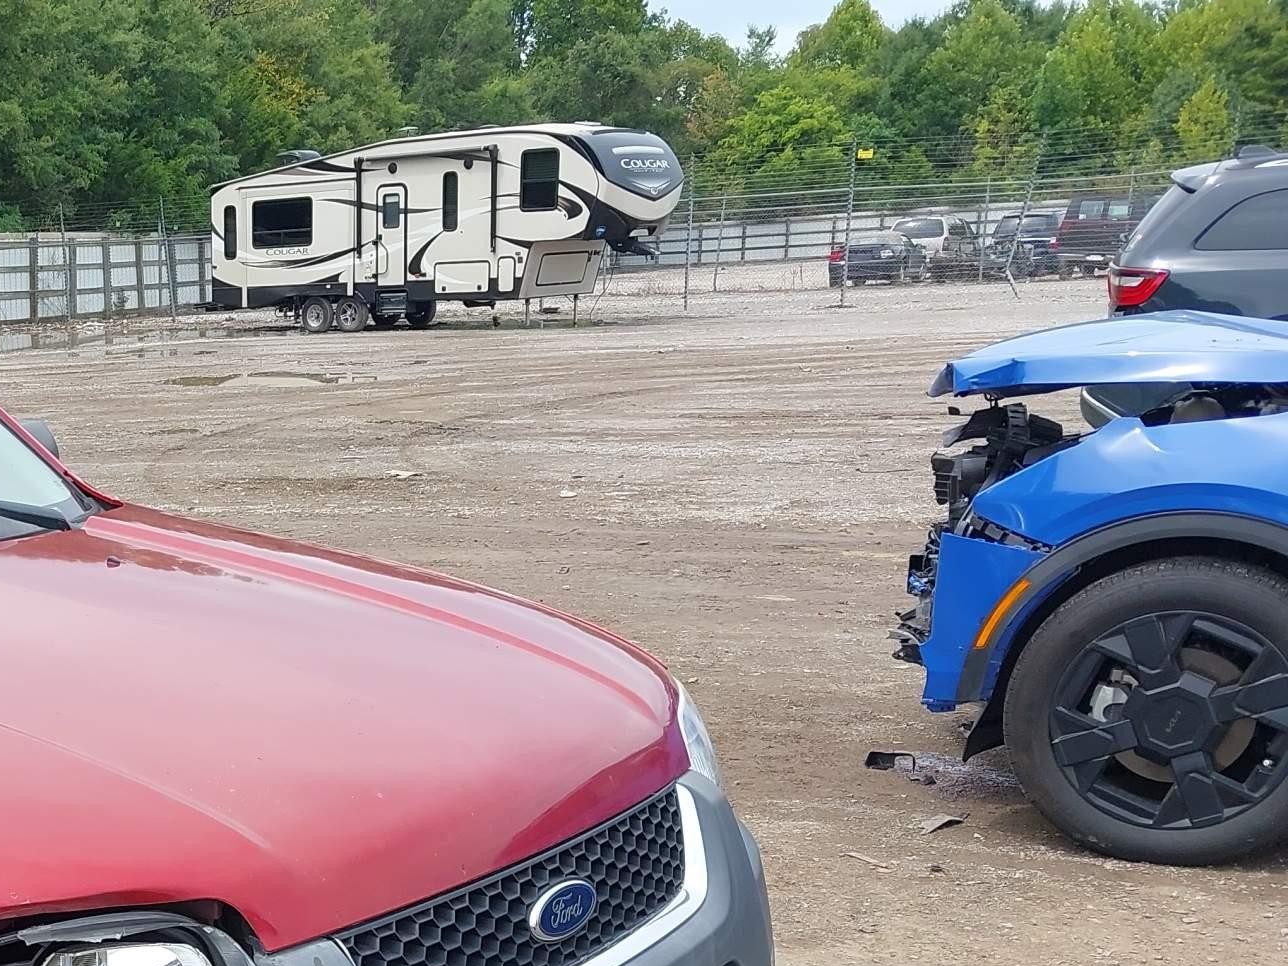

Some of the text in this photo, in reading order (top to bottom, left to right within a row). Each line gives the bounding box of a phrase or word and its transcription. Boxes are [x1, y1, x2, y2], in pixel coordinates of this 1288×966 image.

[620, 158, 671, 169] COUGAR
[265, 247, 311, 256] COUGAR
[551, 892, 583, 928] Ford
